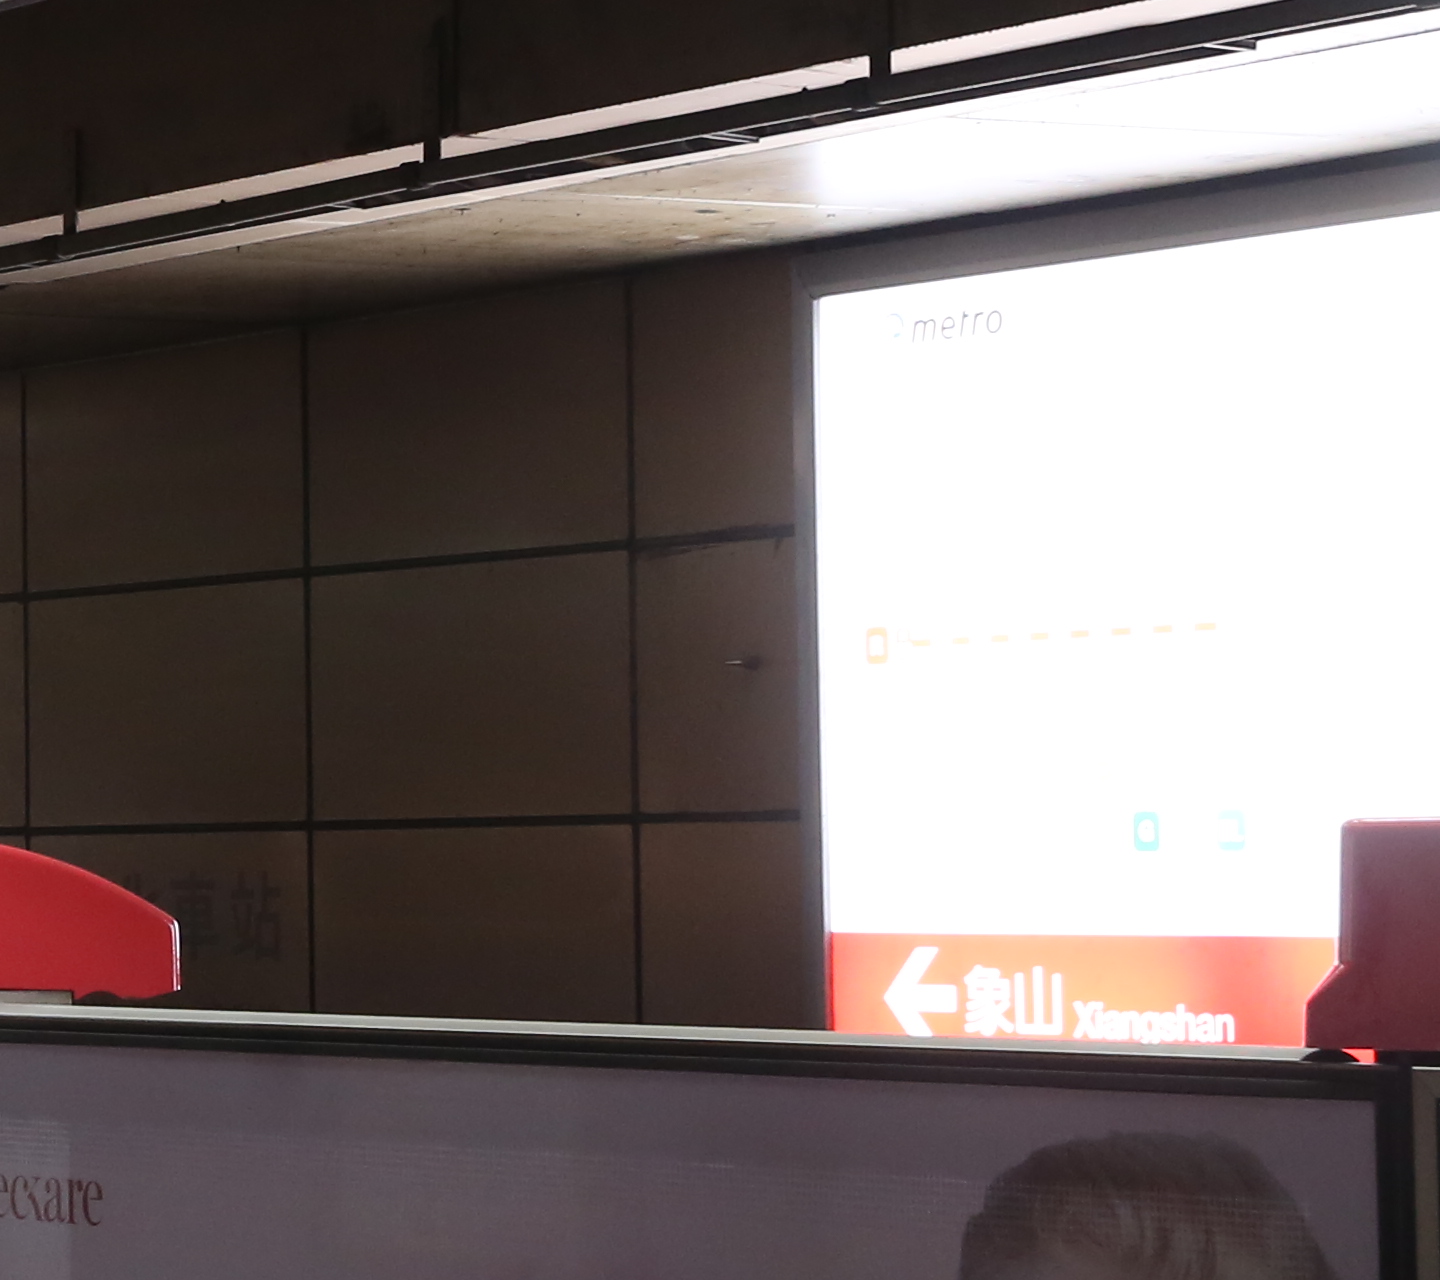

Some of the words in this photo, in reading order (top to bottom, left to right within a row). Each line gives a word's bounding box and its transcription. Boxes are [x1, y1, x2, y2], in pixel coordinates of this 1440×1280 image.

[910, 309, 1003, 343] metro
[964, 964, 1063, 1038] 象山
[1073, 999, 1236, 1045] Xiangshan
